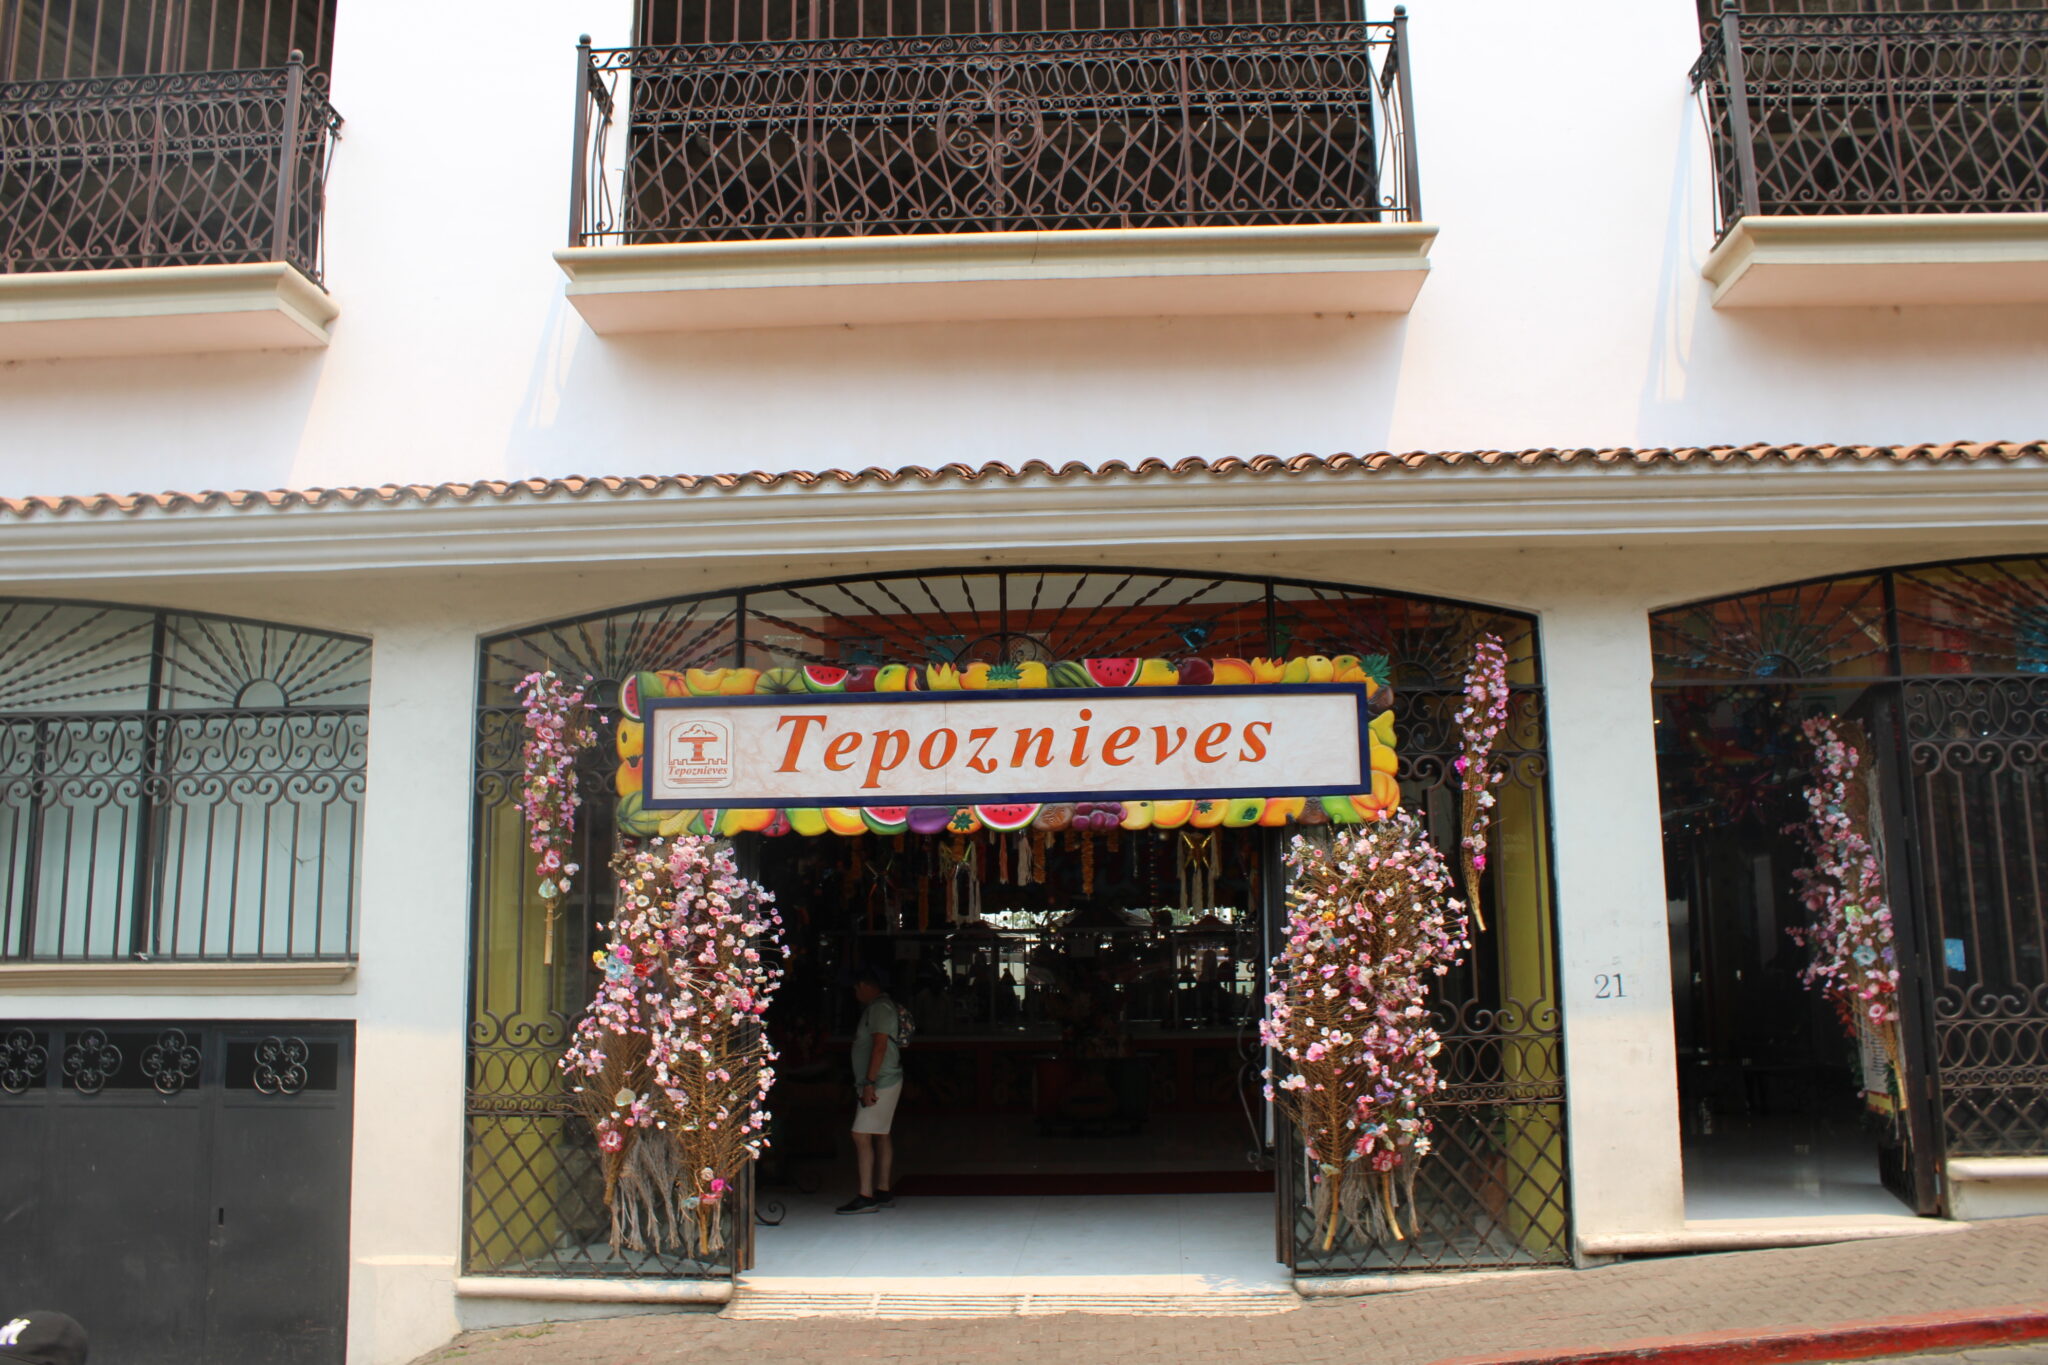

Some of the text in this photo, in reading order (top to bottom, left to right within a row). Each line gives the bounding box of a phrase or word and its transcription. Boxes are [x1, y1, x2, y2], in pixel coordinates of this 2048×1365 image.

[773, 708, 1273, 790] Tepoznieves
[667, 765, 729, 777] Tepoznieves
[1594, 972, 1628, 999] 21
